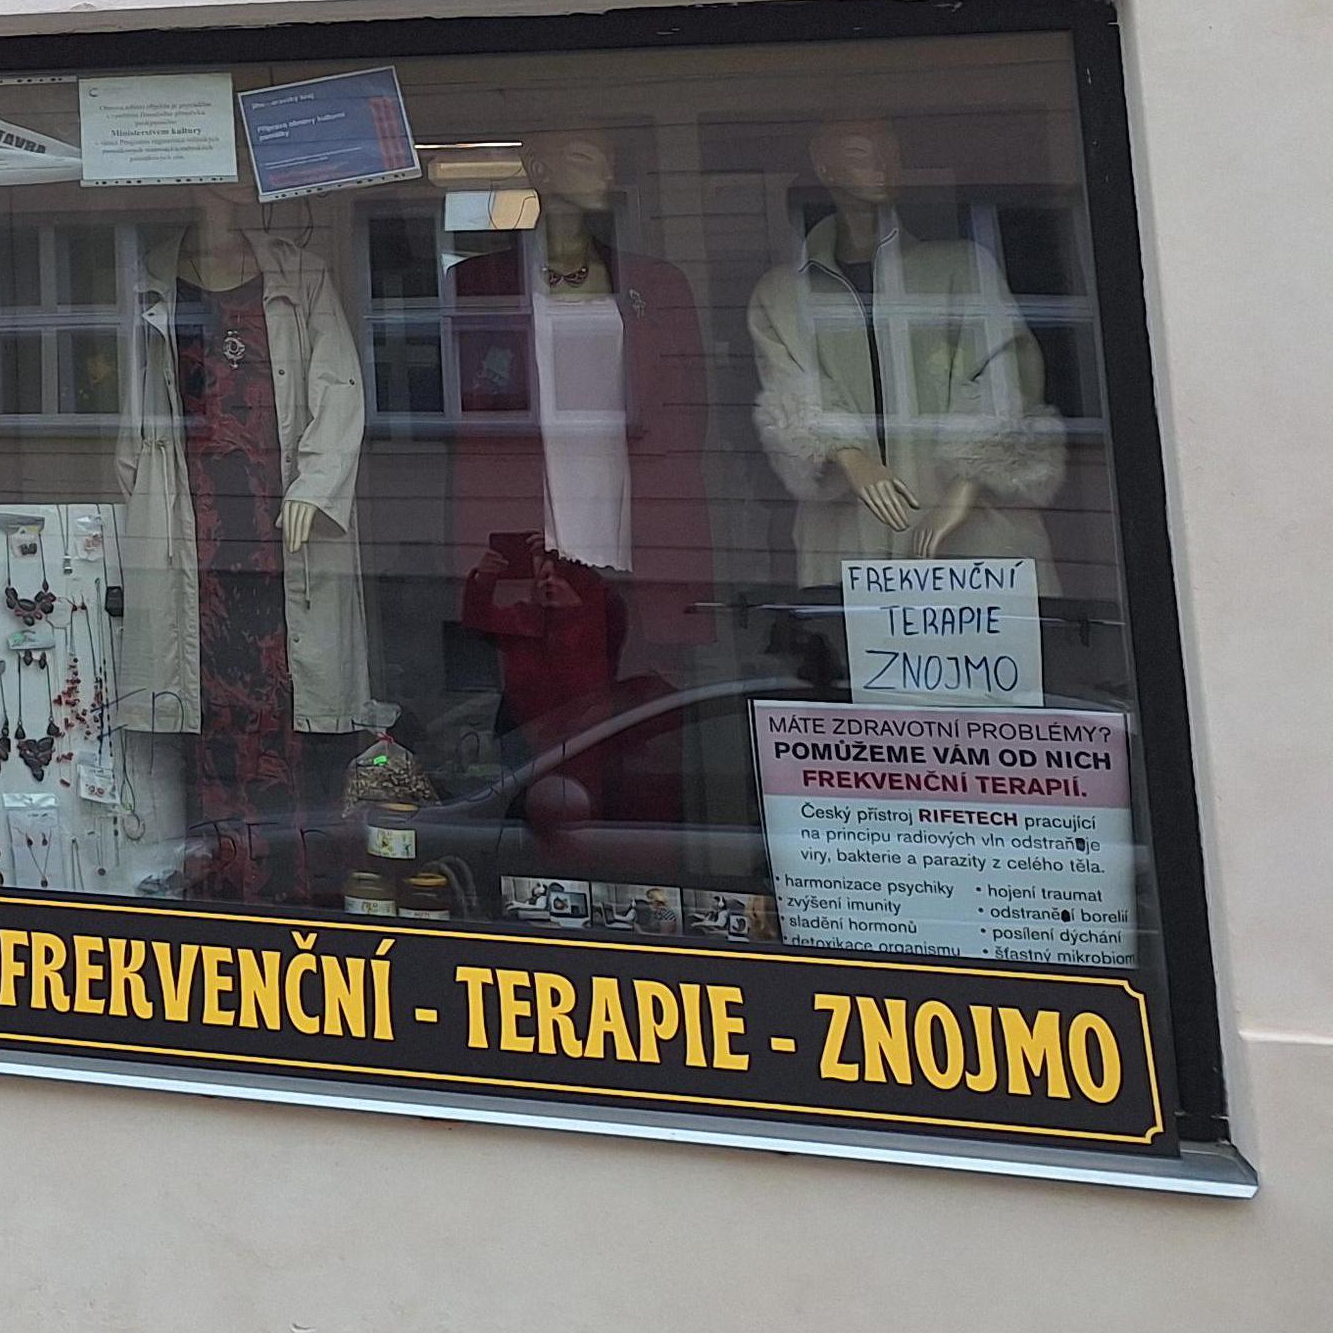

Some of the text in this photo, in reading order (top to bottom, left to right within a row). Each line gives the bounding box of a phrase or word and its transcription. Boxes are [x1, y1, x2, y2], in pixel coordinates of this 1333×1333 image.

[848, 561, 1023, 592] FREKVENČNÍ
[880, 605, 1001, 636] TERAPIE
[863, 650, 1018, 692] ZNOJMO
[769, 715, 1111, 743] MÁTE ZDRAVOTNÍ PROBLÉMY?
[774, 740, 1111, 770] POMŮŽEME VÁM OD NICH
[803, 770, 1087, 797] FREKVENČNÍ TERAPIÍ.
[801, 802, 1096, 832] Český přístroj RIFETECH pracující
[801, 828, 1100, 855] na principu radiových vln odstraňje
[801, 849, 1105, 874] viry, bakterie a parazity z celého těla.
[785, 874, 954, 898] harmonizace psychiky
[988, 884, 1102, 902] hojení traumat
[787, 895, 901, 916] zvýšení imunity
[990, 906, 1128, 923] odstraněí borelií
[789, 916, 917, 934] sladění hormonů
[993, 927, 1122, 945] posílení dýchání
[995, 946, 1051, 962] šťastný
[455, 966, 750, 1072] TERAPIE
[813, 994, 1121, 1104] ZNOJMO
